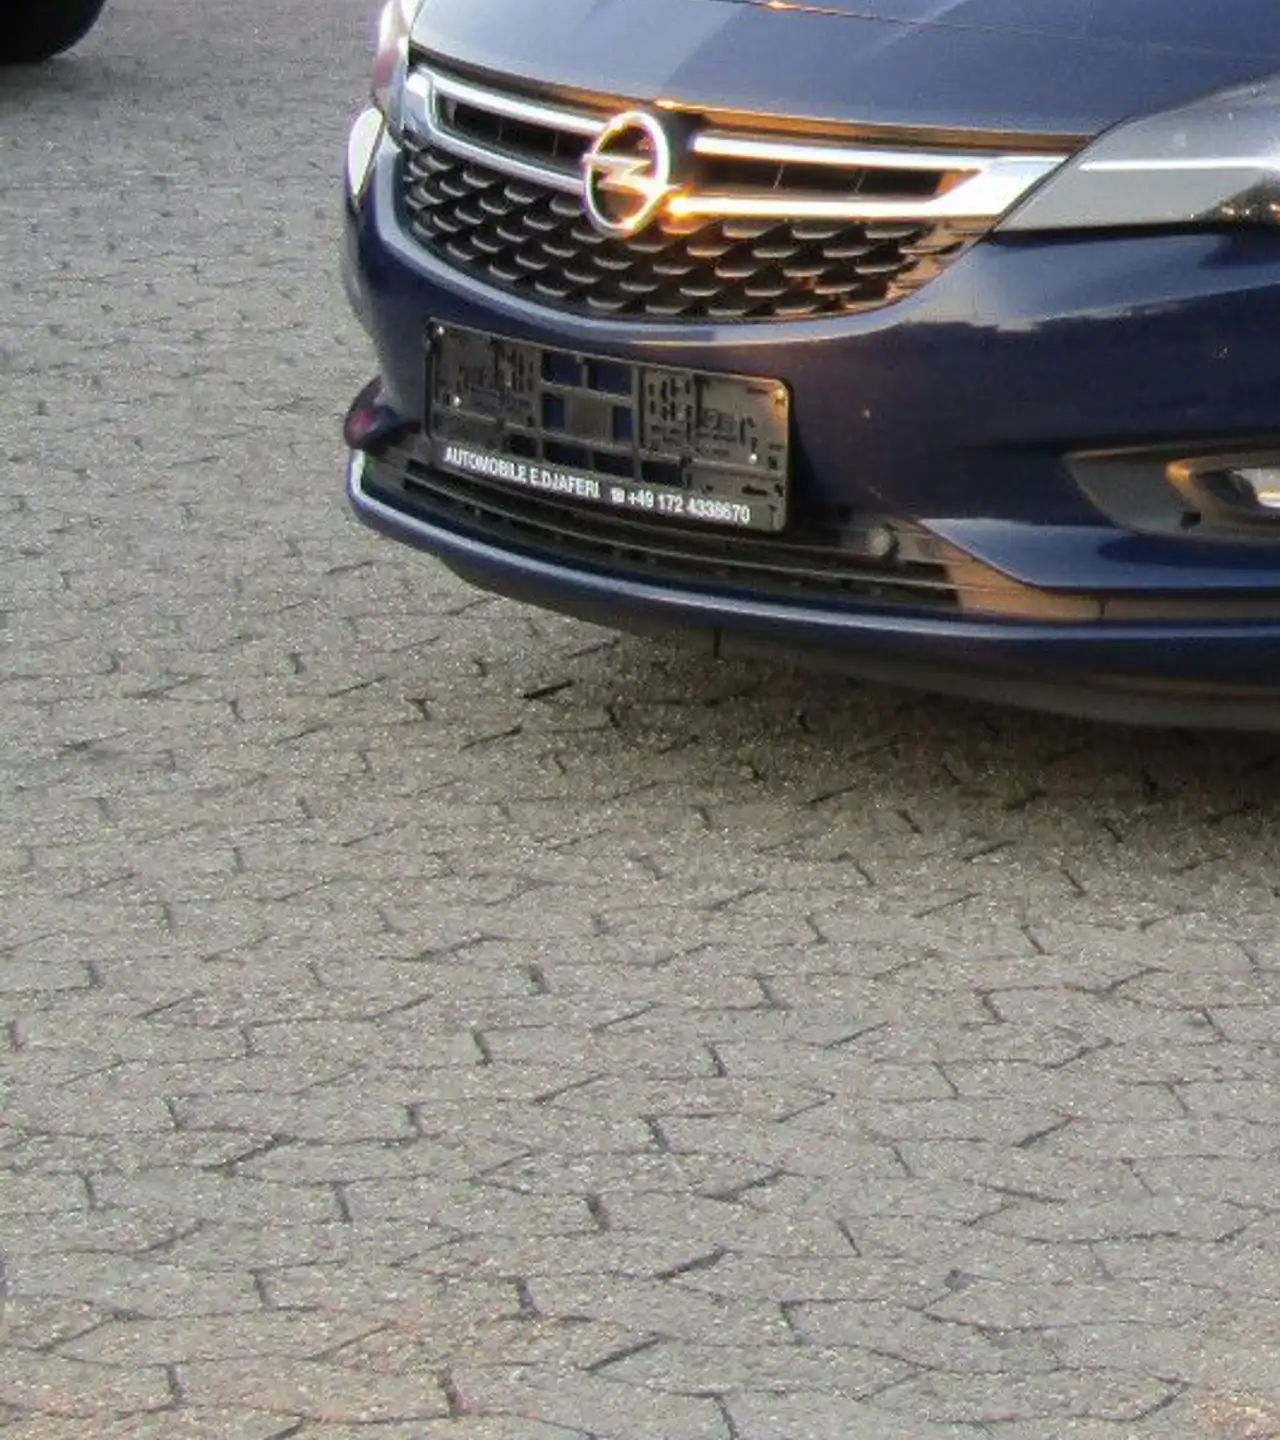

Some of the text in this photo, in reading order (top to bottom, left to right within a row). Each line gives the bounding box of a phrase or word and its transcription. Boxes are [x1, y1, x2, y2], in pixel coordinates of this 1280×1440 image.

[443, 446, 527, 484] AUTOMOBILE
[627, 490, 655, 509] +49
[657, 492, 684, 514] 172
